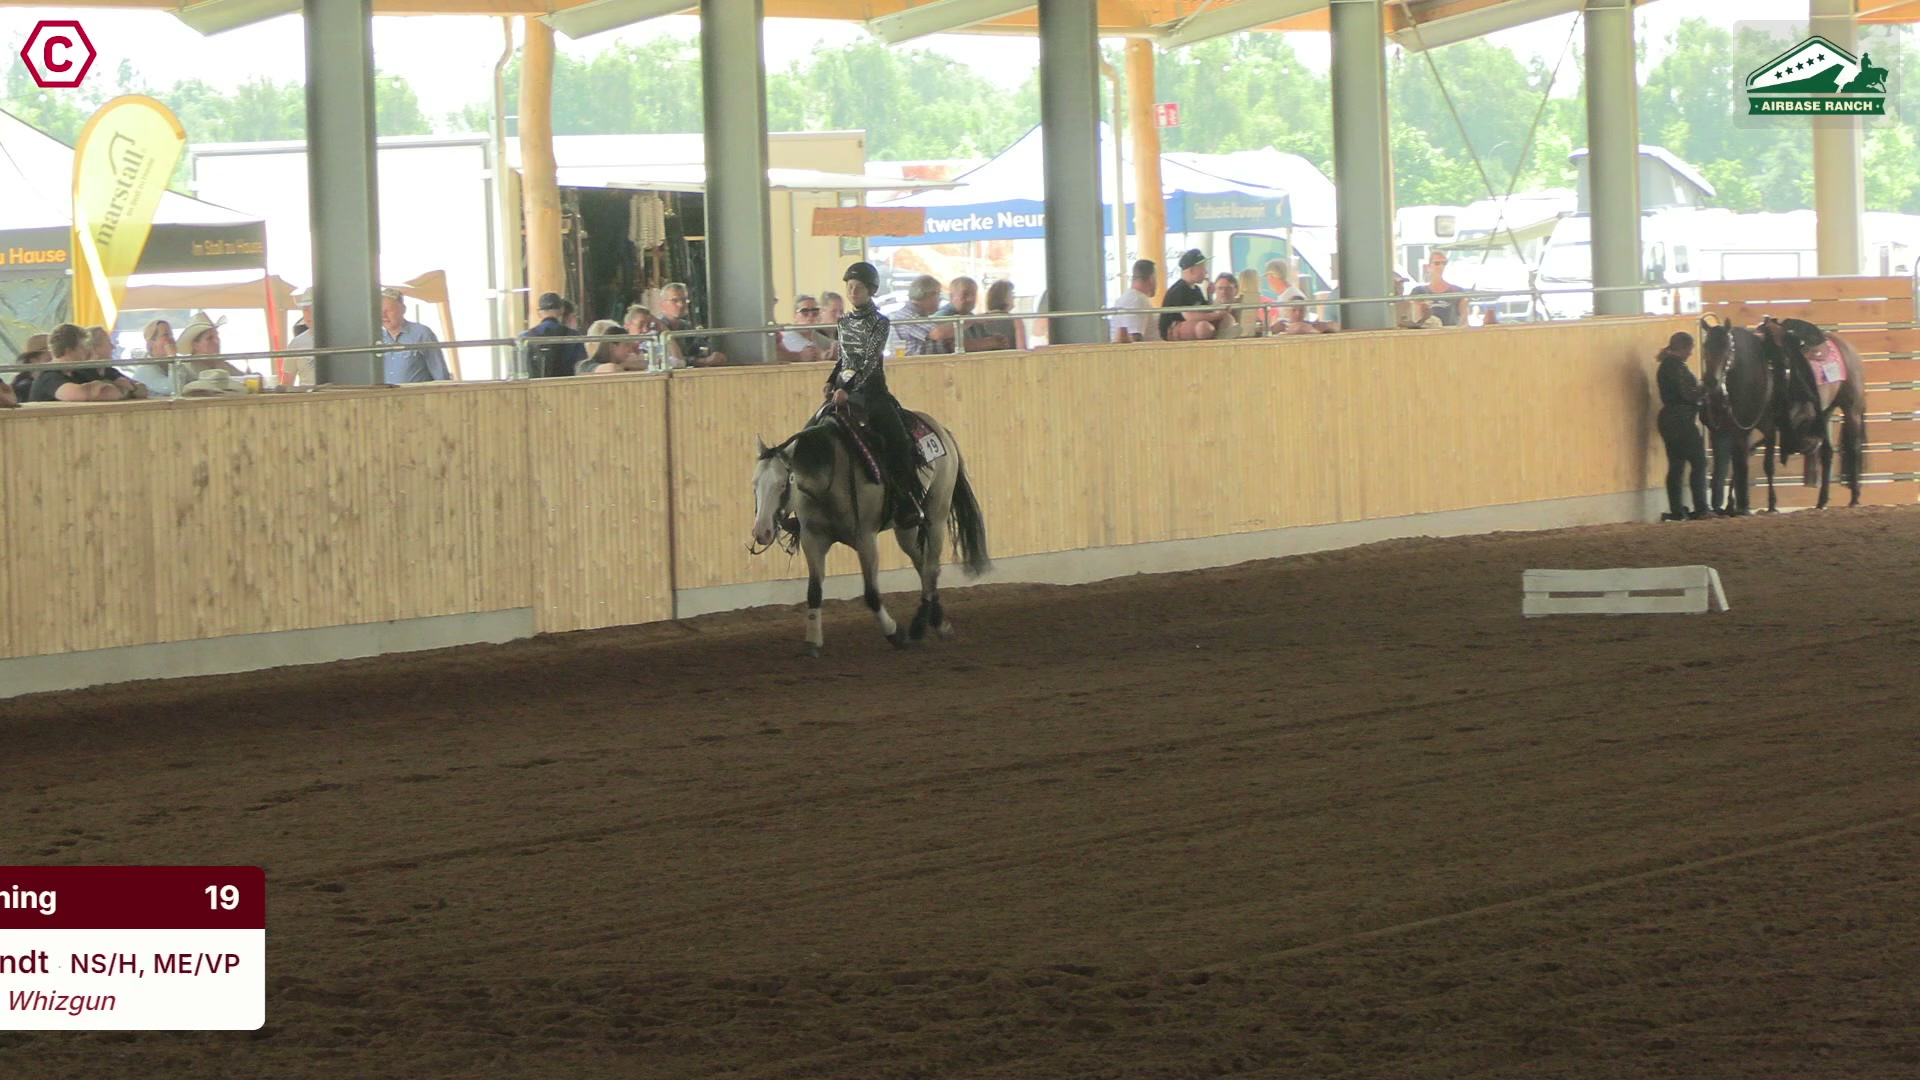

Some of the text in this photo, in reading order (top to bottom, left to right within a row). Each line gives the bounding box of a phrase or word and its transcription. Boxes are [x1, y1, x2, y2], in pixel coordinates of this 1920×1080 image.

[97, 149, 145, 246] marstall
[9, 247, 67, 265] Hause
[926, 438, 939, 453] 19
